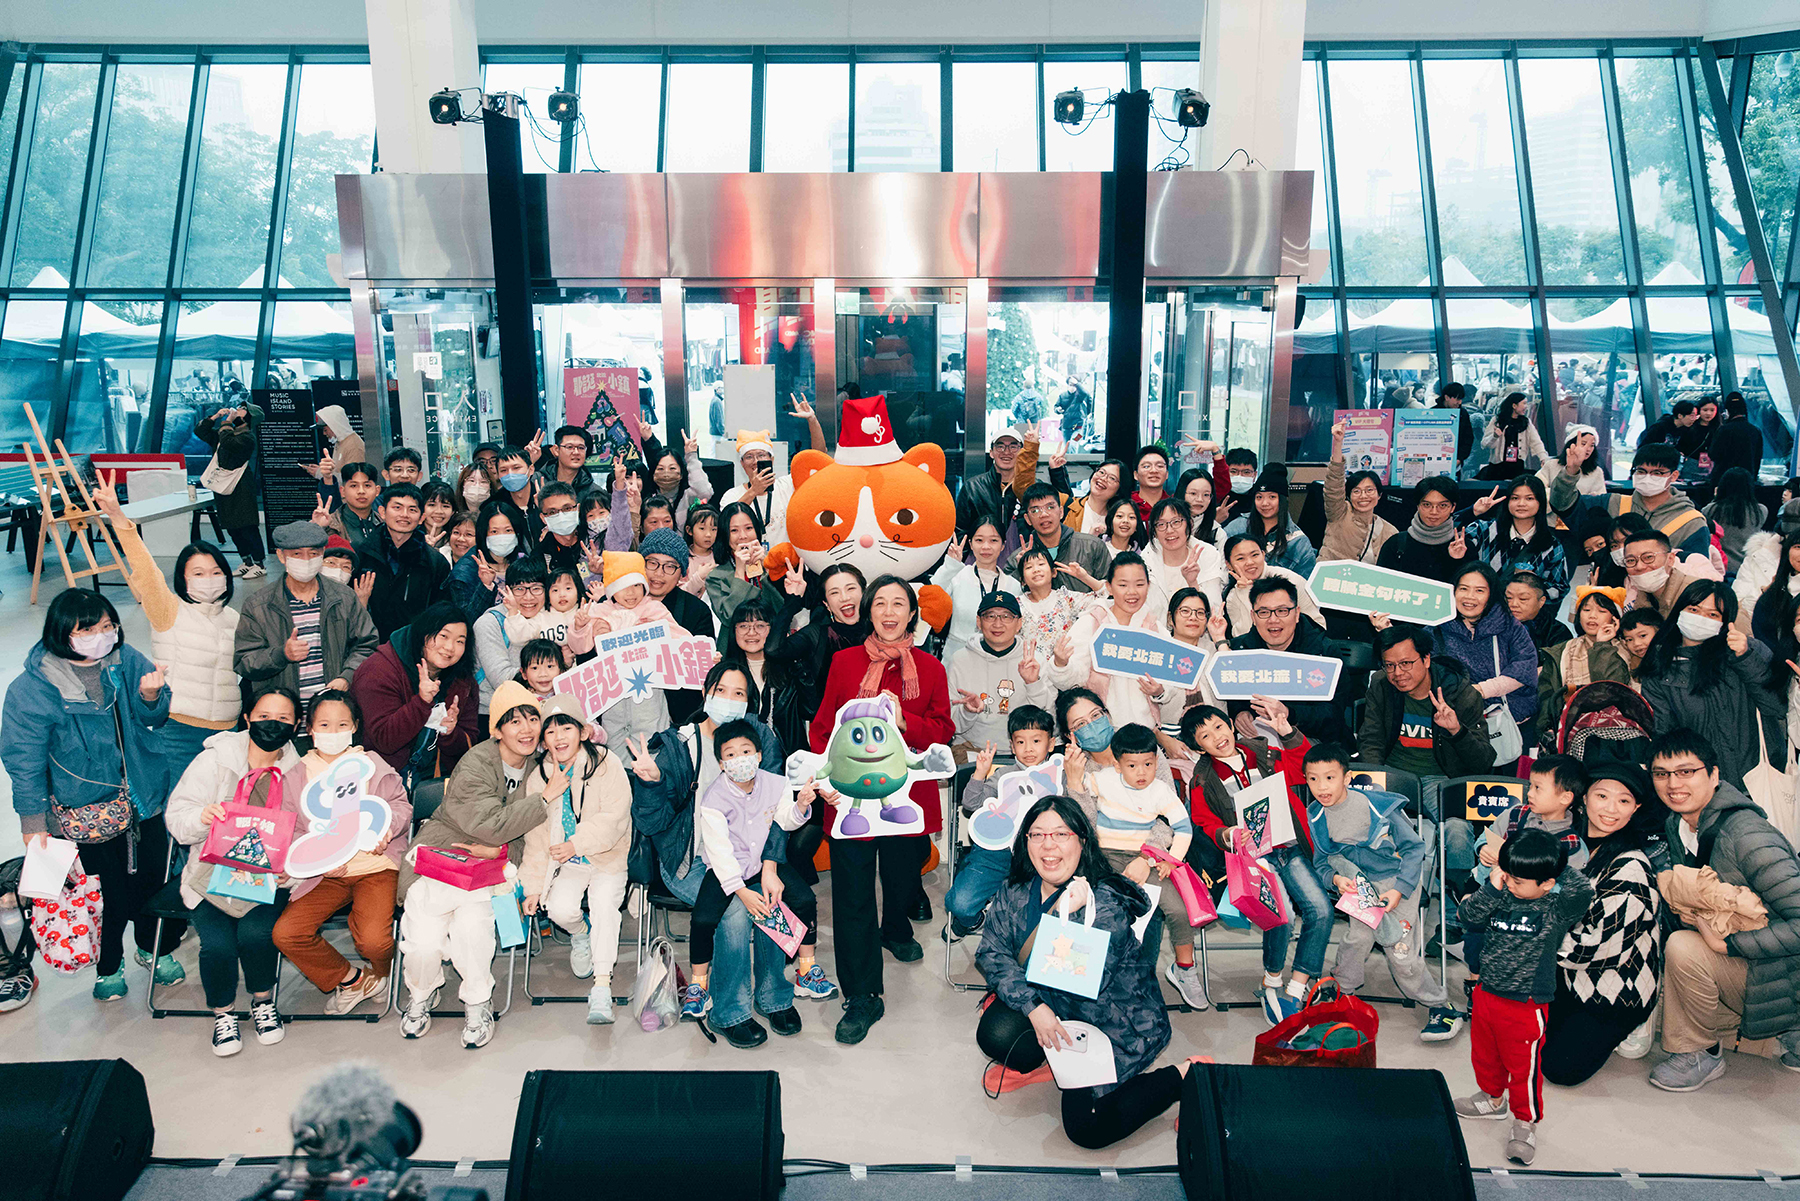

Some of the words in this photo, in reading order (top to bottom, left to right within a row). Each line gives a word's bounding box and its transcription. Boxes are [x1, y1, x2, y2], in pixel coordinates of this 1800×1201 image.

[601, 625, 665, 652] 歡迎光臨
[621, 646, 649, 664] 北流
[1477, 795, 1510, 808] 貴賓席
